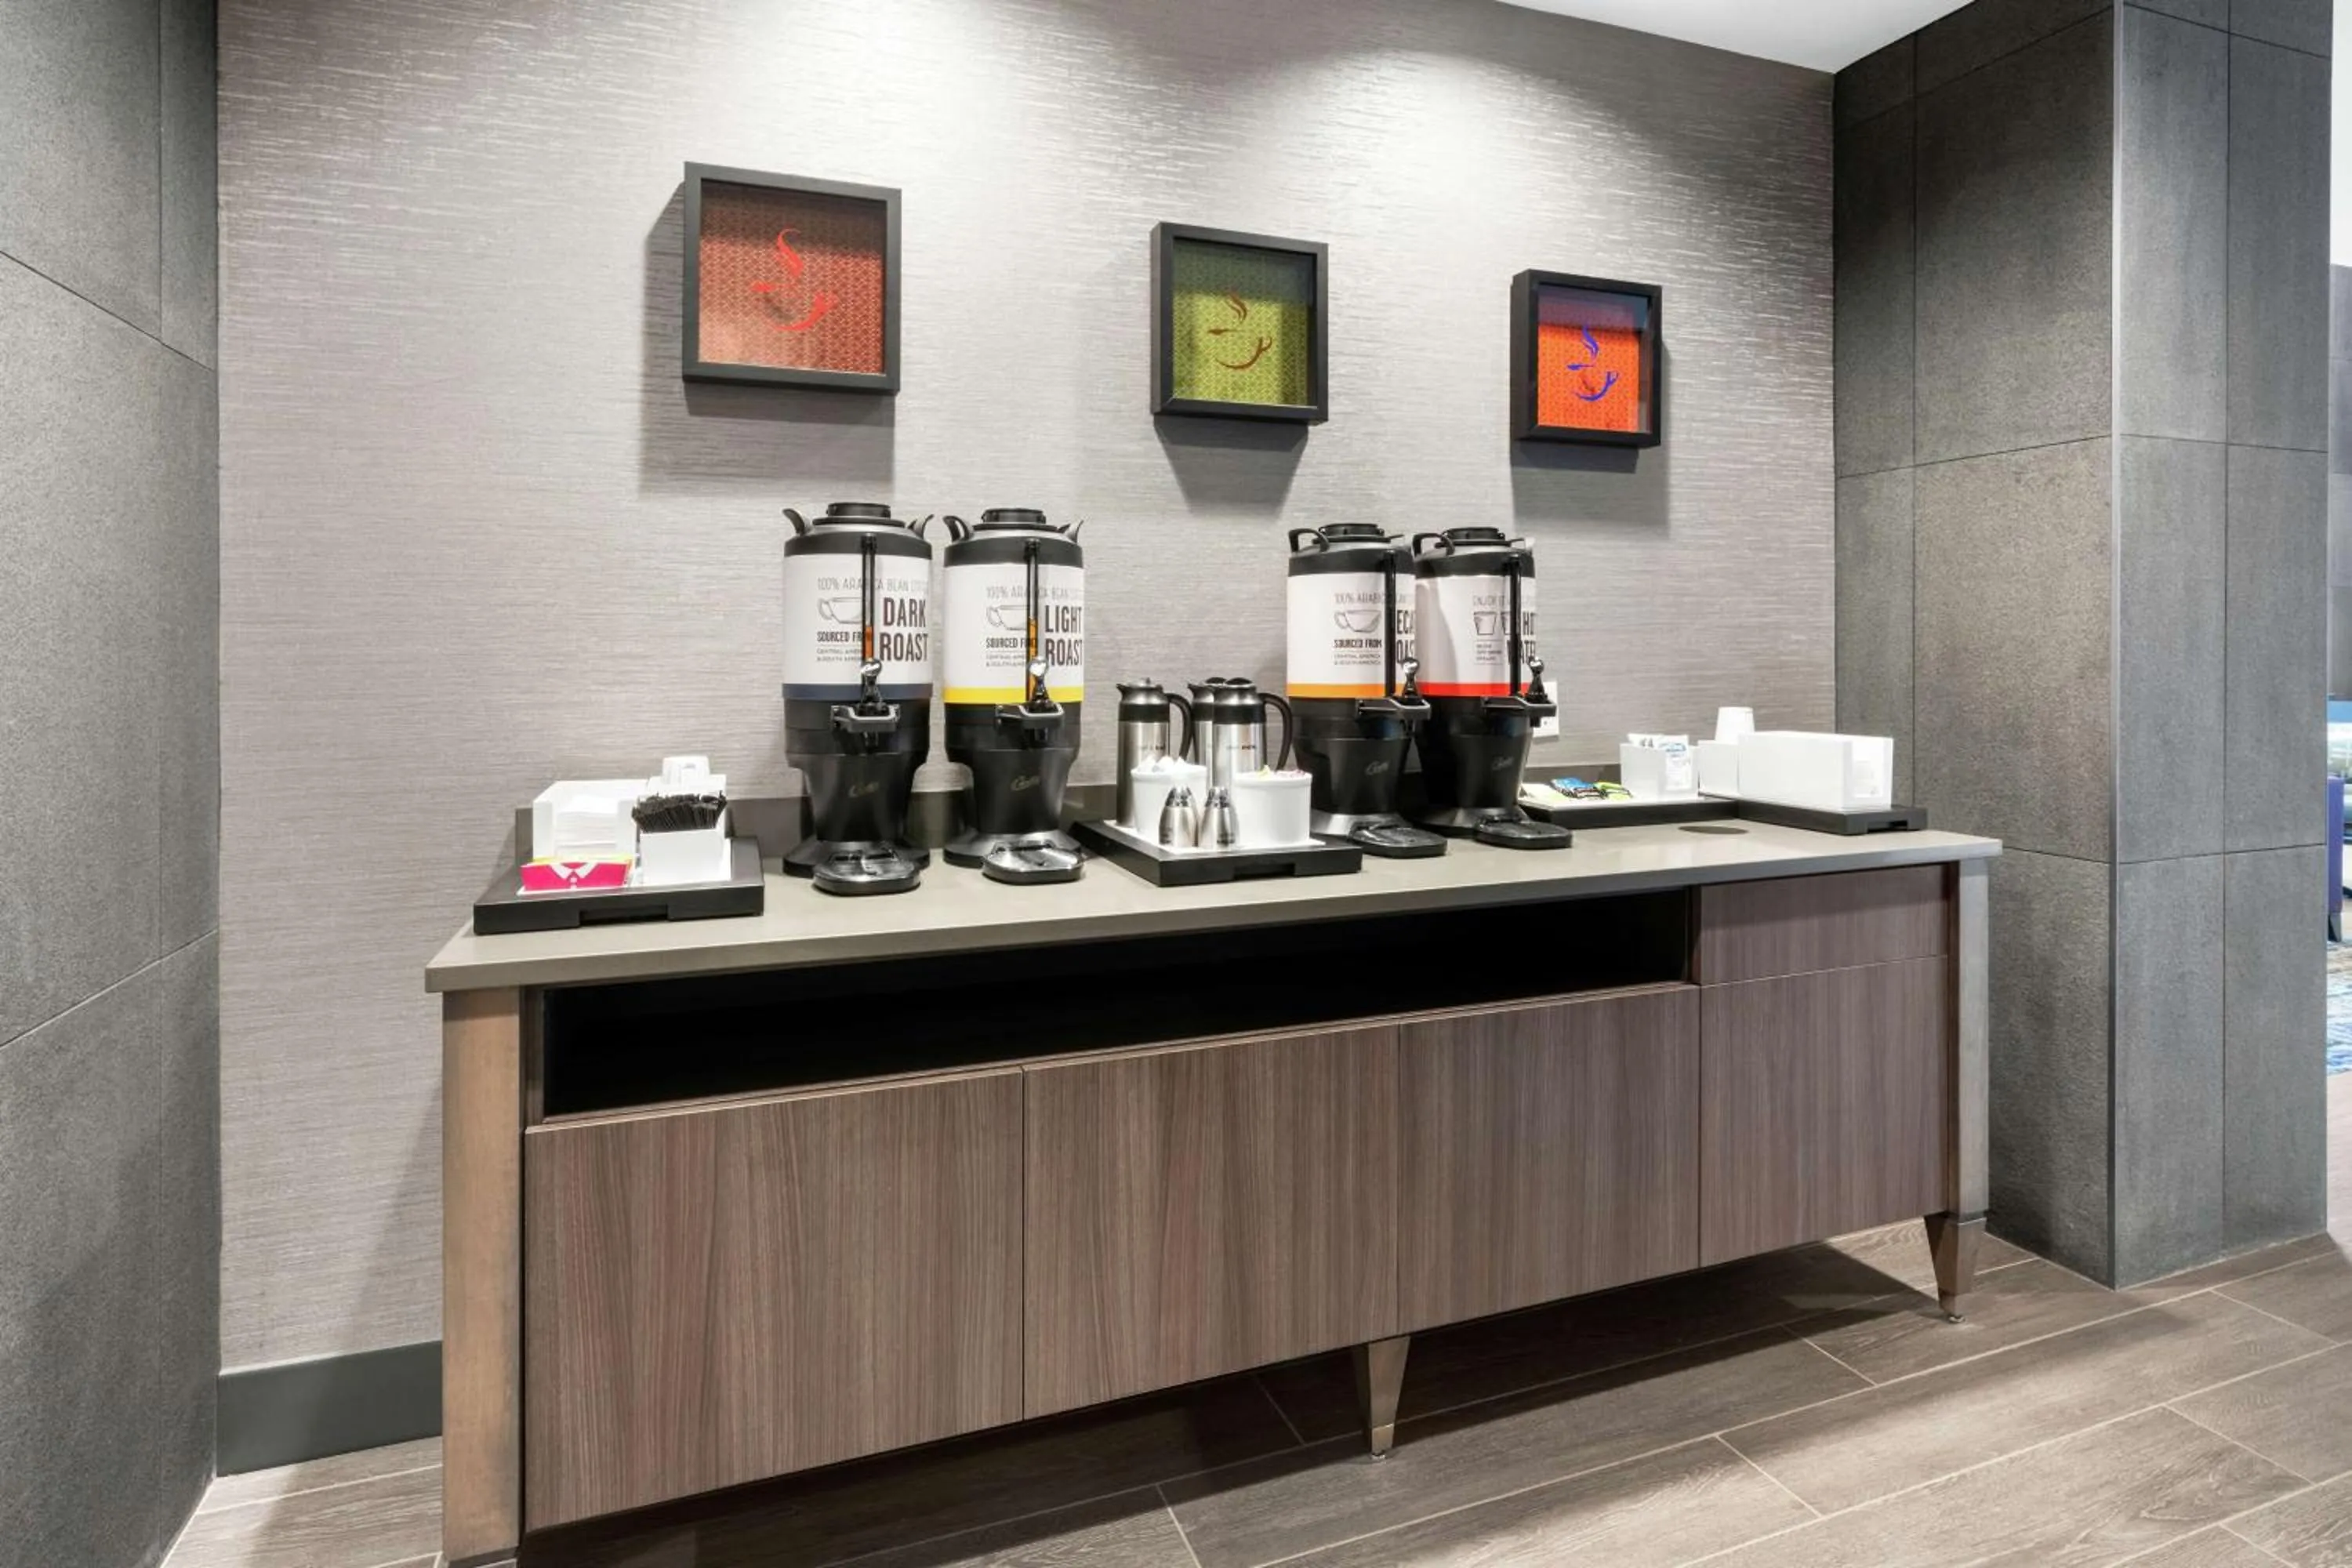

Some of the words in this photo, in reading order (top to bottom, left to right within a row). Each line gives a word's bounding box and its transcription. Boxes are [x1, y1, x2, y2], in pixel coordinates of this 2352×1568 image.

[883, 597, 927, 628] DARK
[1044, 604, 1083, 633] LIGHT
[1396, 609, 1415, 634] ECA
[1523, 612, 1537, 636] HO
[816, 630, 850, 643] SOURCED
[879, 631, 929, 662] ROAST
[985, 637, 1018, 648] SOURCED
[1044, 638, 1083, 666] ROAST
